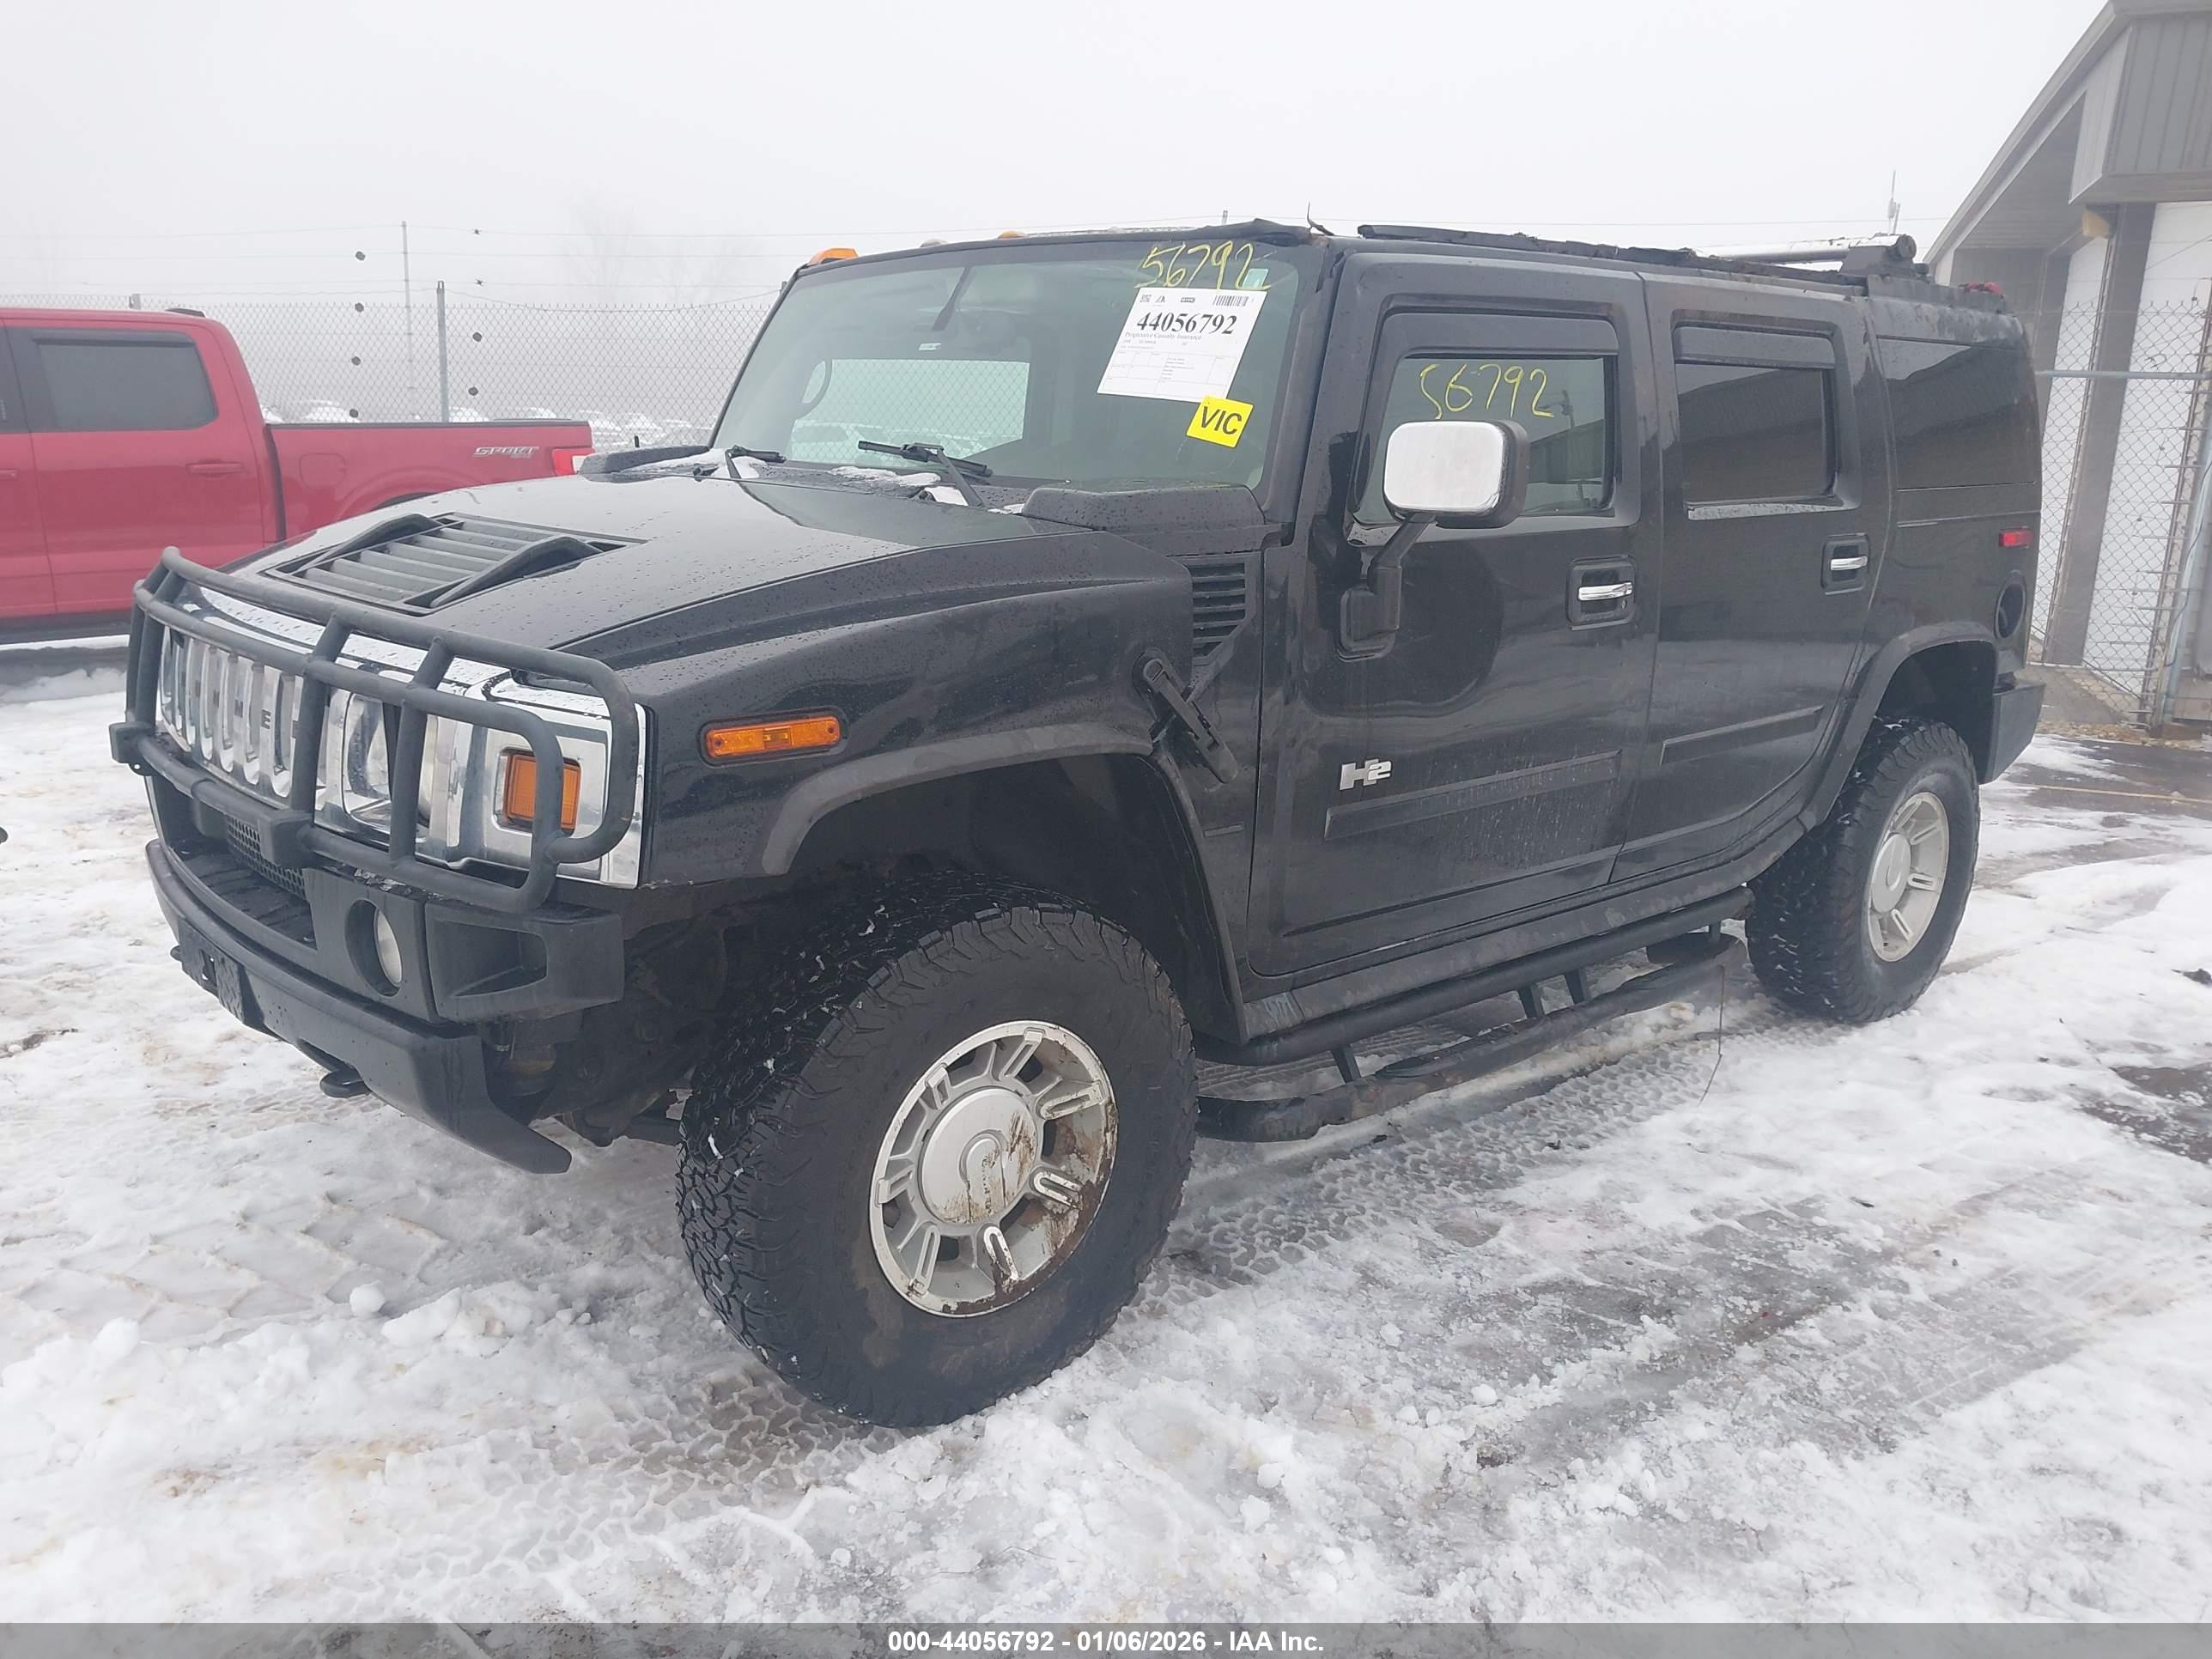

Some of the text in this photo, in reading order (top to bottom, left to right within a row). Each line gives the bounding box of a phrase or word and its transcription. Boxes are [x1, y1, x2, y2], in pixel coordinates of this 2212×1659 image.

[1133, 240, 1273, 289] 56792
[1137, 312, 1237, 334] 44056792
[1419, 363, 1555, 420] 56792
[1200, 406, 1242, 434] VIC
[1340, 758, 1392, 790] H2
